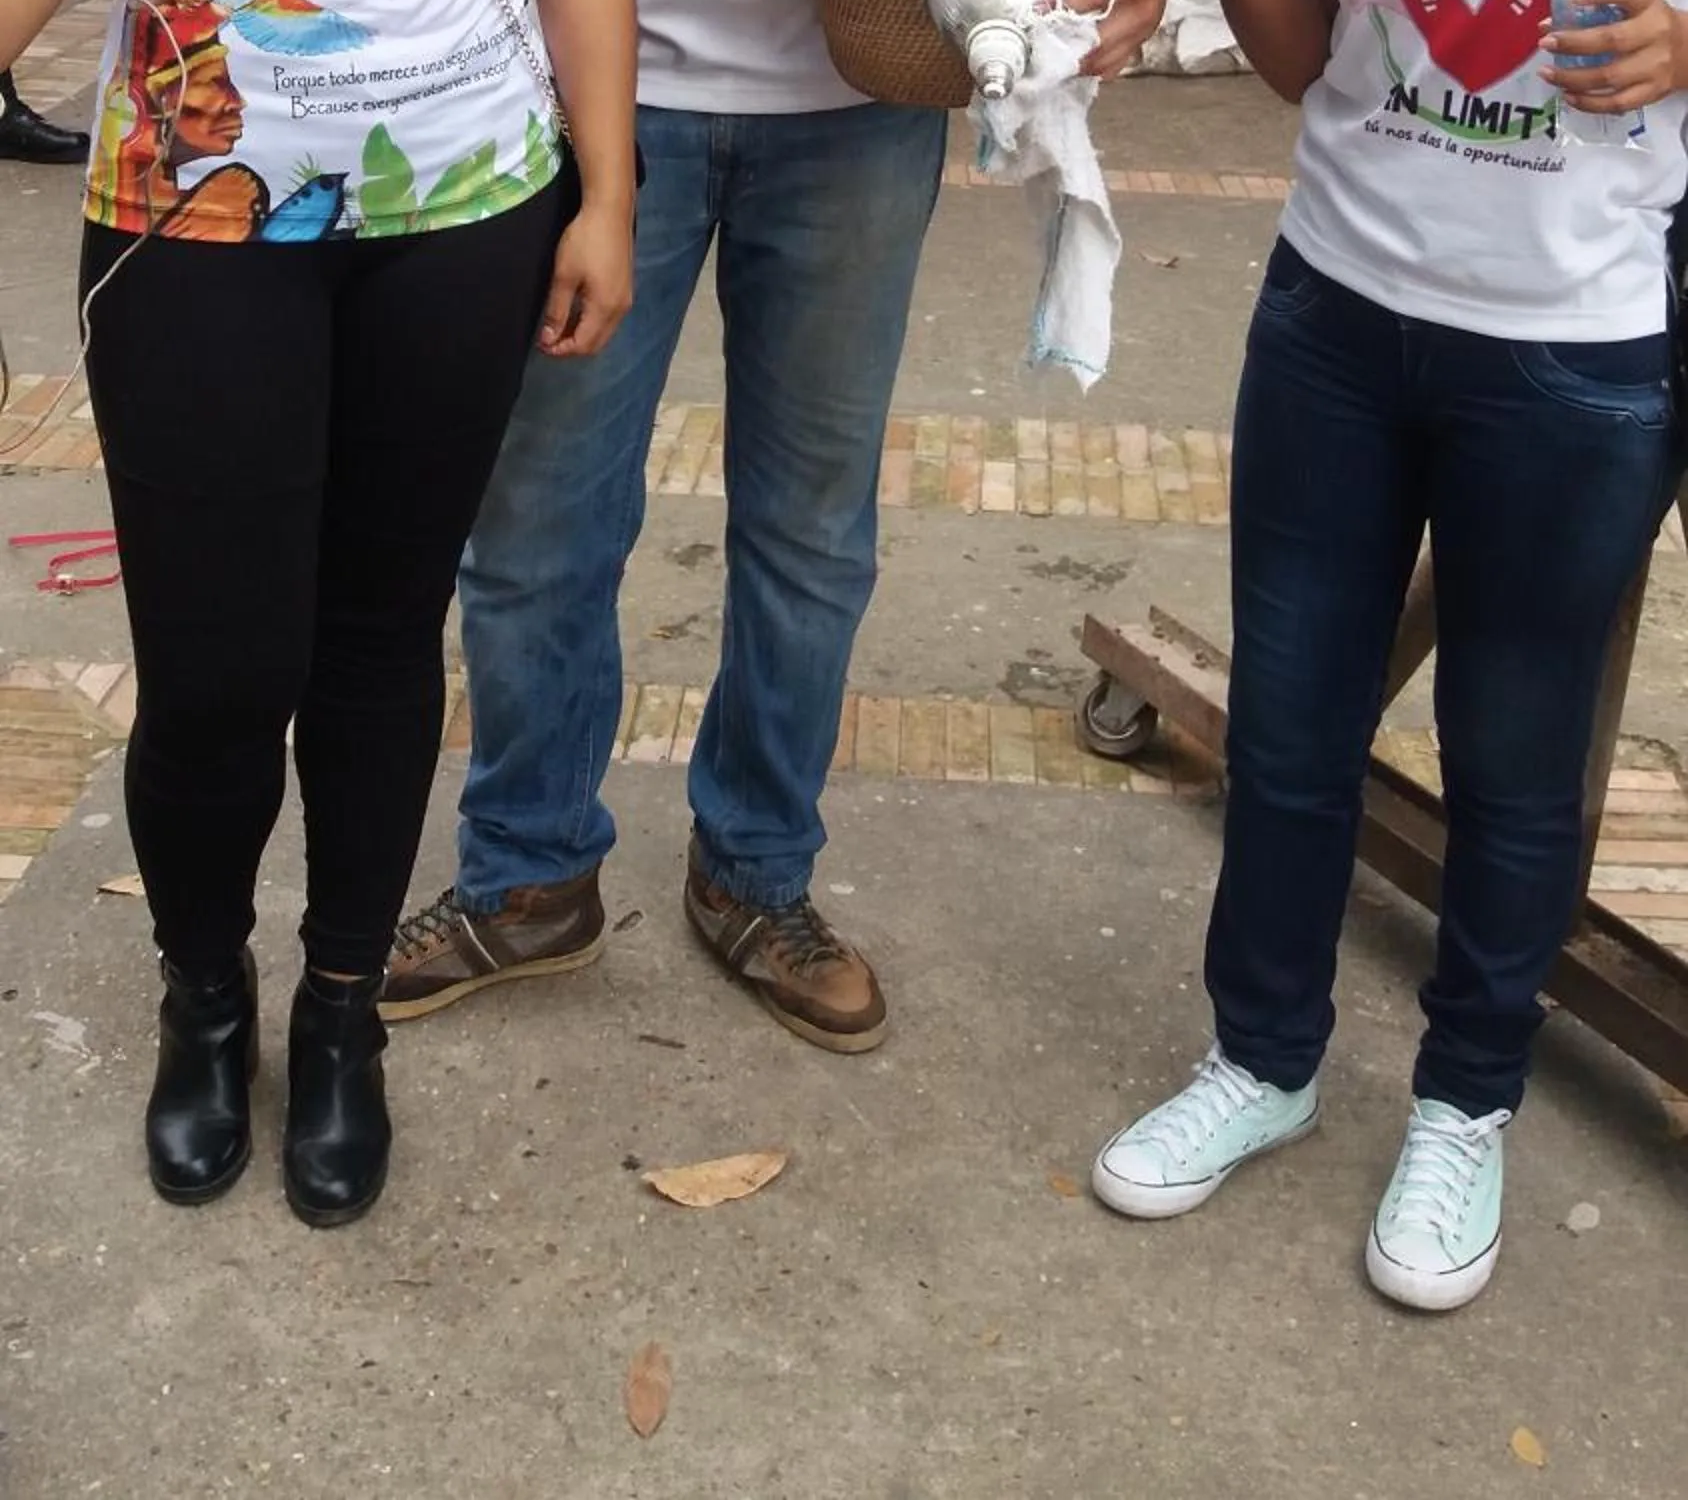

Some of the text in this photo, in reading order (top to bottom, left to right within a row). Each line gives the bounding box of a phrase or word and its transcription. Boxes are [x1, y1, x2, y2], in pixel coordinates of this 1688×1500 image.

[273, 65, 326, 97] Porque
[329, 62, 367, 86] todo
[369, 65, 418, 82] merece
[421, 59, 444, 75] una
[291, 95, 359, 119] Because
[1365, 119, 1379, 134] tú
[1385, 127, 1412, 142] nos
[1418, 132, 1441, 149] das
[1445, 137, 1457, 154] la
